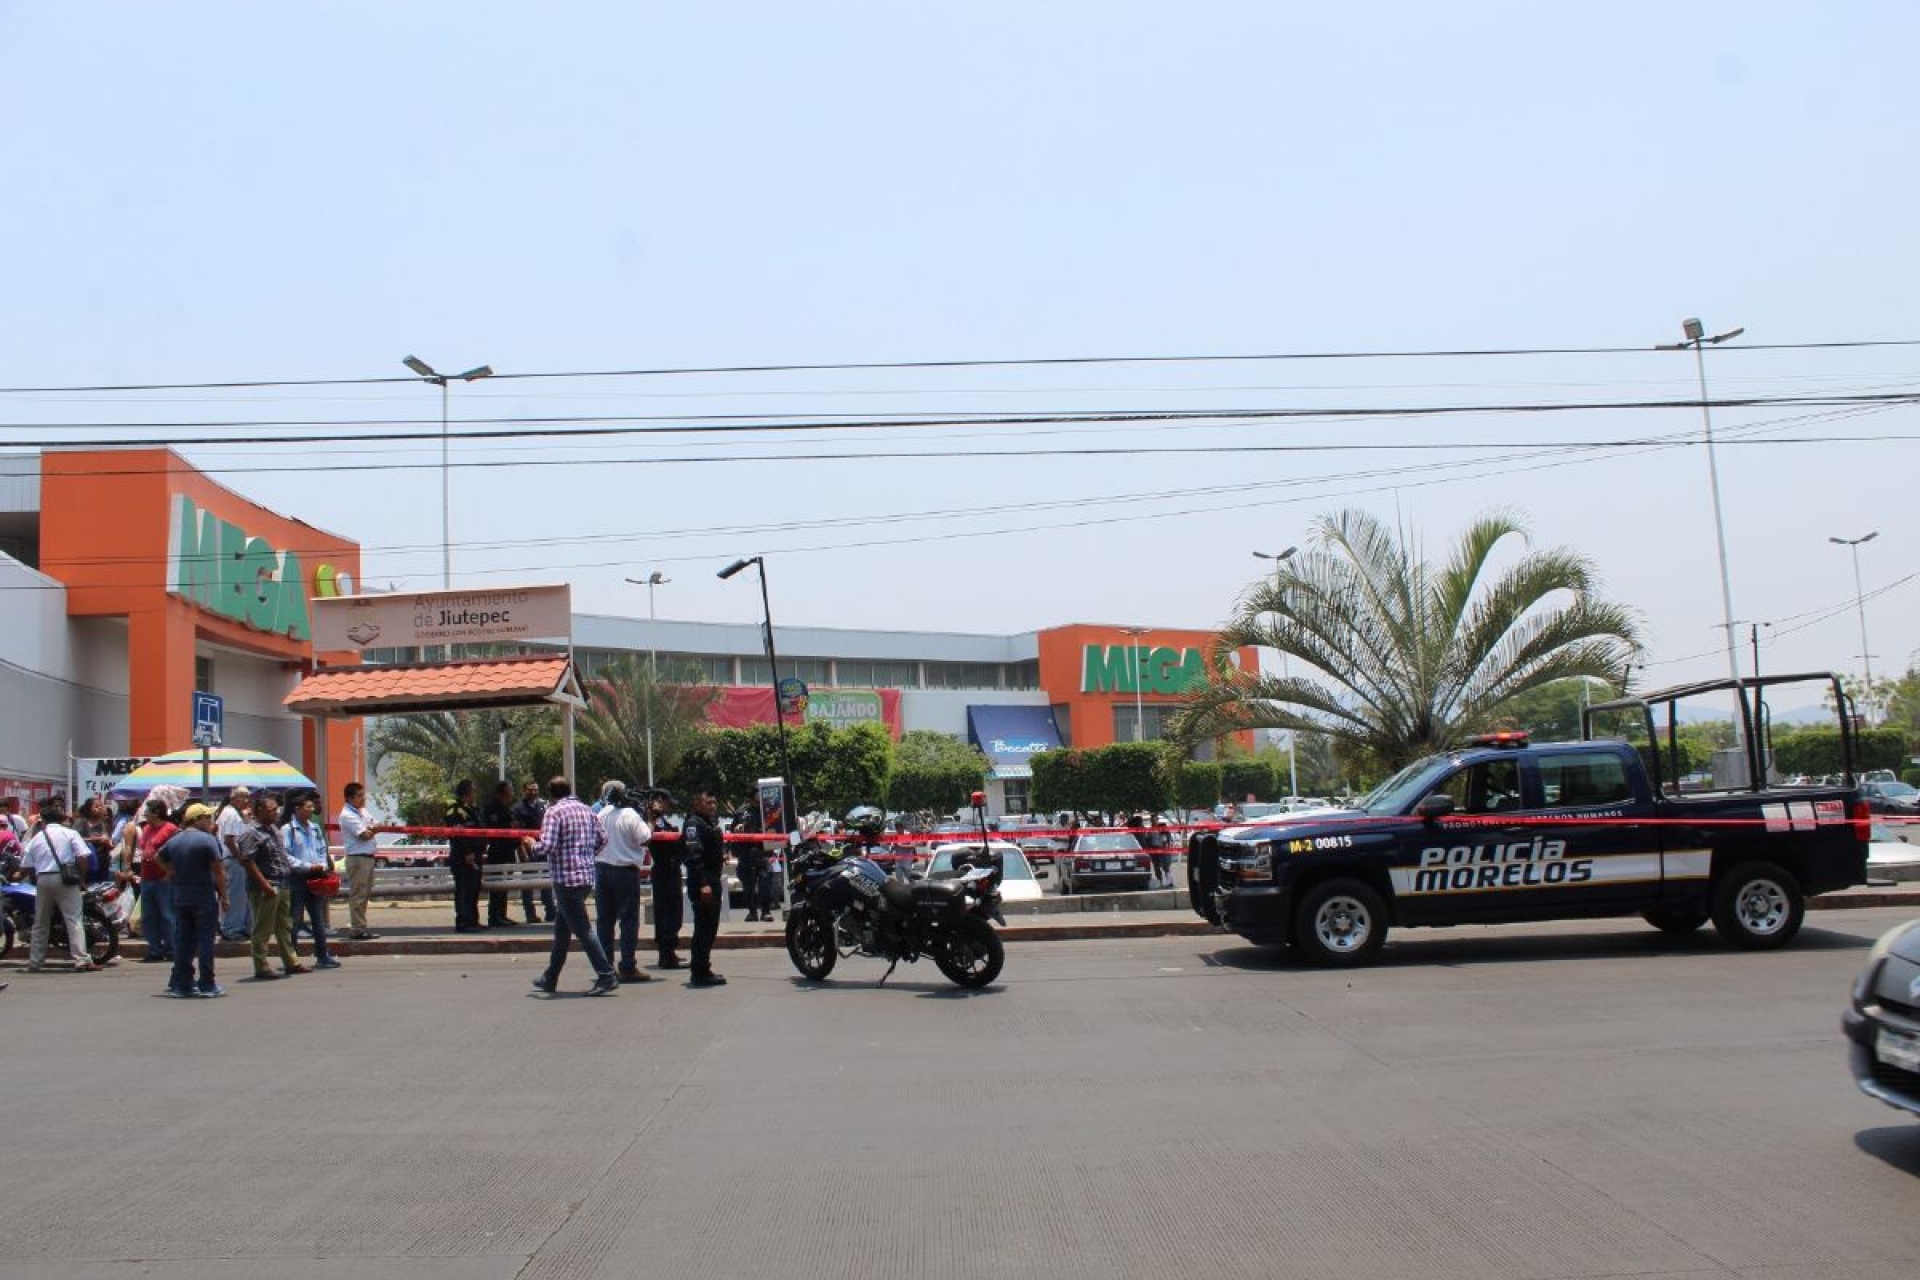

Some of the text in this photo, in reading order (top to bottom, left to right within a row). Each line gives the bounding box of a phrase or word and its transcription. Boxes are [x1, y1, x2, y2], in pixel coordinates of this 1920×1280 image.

[166, 493, 312, 641] MEGA
[414, 591, 527, 611] Ayuntamiento
[414, 609, 510, 628] de Jiutepec
[1080, 643, 1210, 694] MEGA
[809, 703, 877, 717] BAJANDO
[86, 780, 96, 791] TE
[1290, 835, 1352, 854] M-2 00815
[1415, 859, 1593, 892] MORELOS
